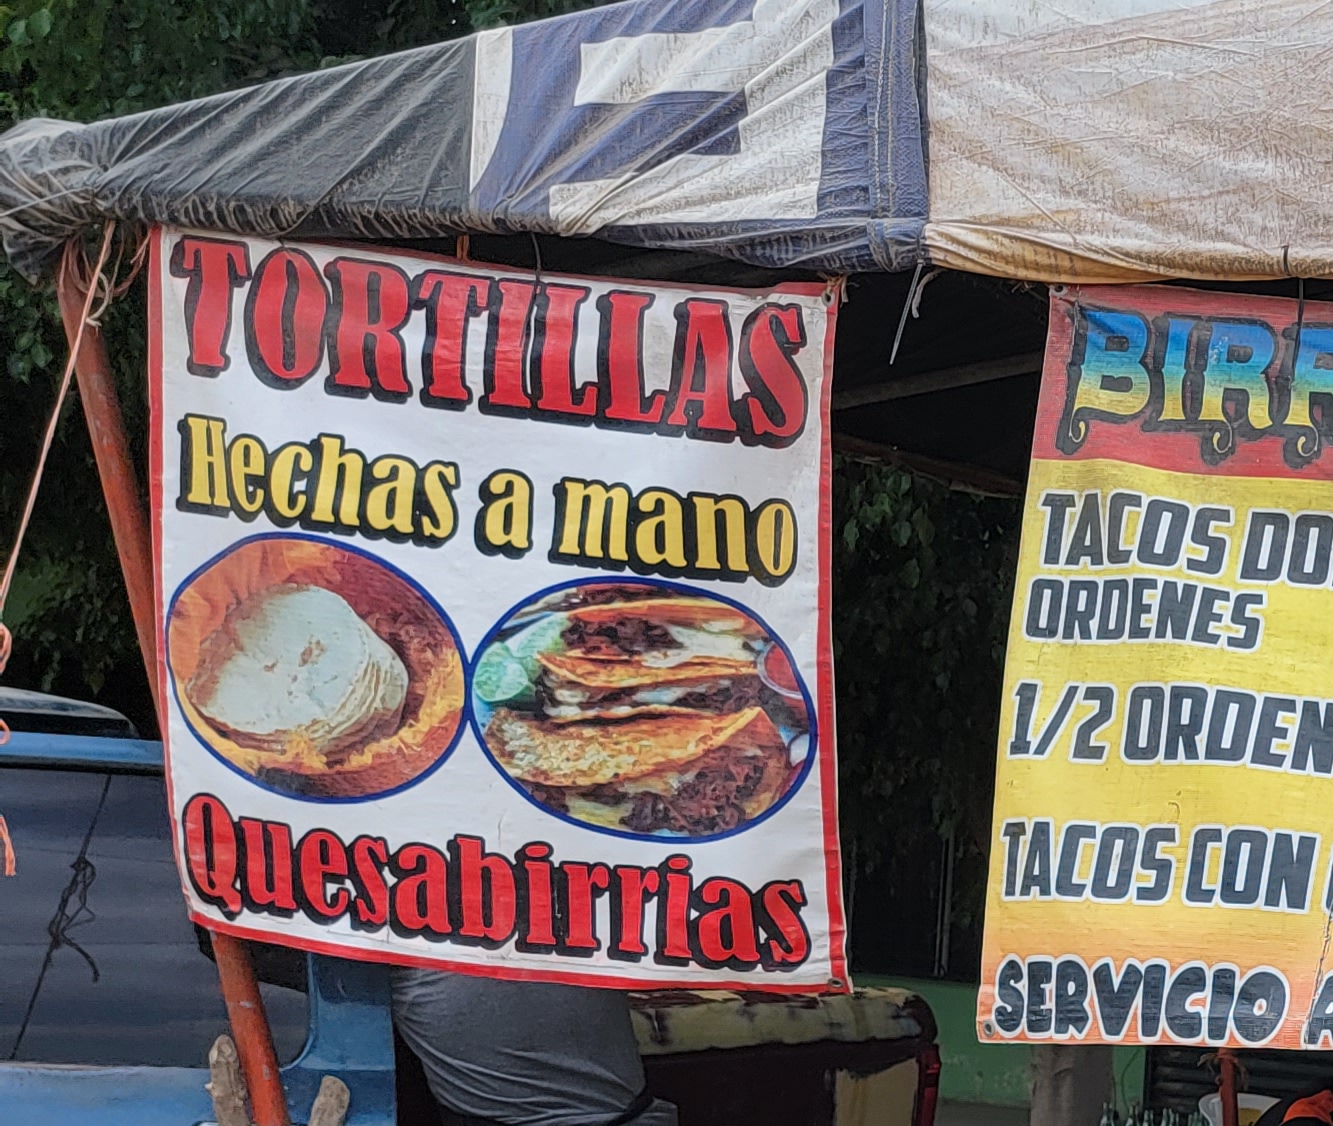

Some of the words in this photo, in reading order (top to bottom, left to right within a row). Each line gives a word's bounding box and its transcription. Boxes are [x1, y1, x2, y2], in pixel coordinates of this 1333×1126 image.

[170, 237, 808, 447] TORTILLAS
[176, 414, 461, 545] Hechas
[475, 470, 534, 559] a
[551, 478, 798, 586] mano
[1038, 490, 1234, 576] TACOS
[1024, 577, 1265, 651] ORDENES
[1007, 681, 1119, 764] 1/2
[181, 792, 811, 967] Quesabirrias
[1002, 820, 1178, 904] TACOS
[1186, 825, 1320, 912] CON
[995, 954, 1290, 1047] SERVICIO
